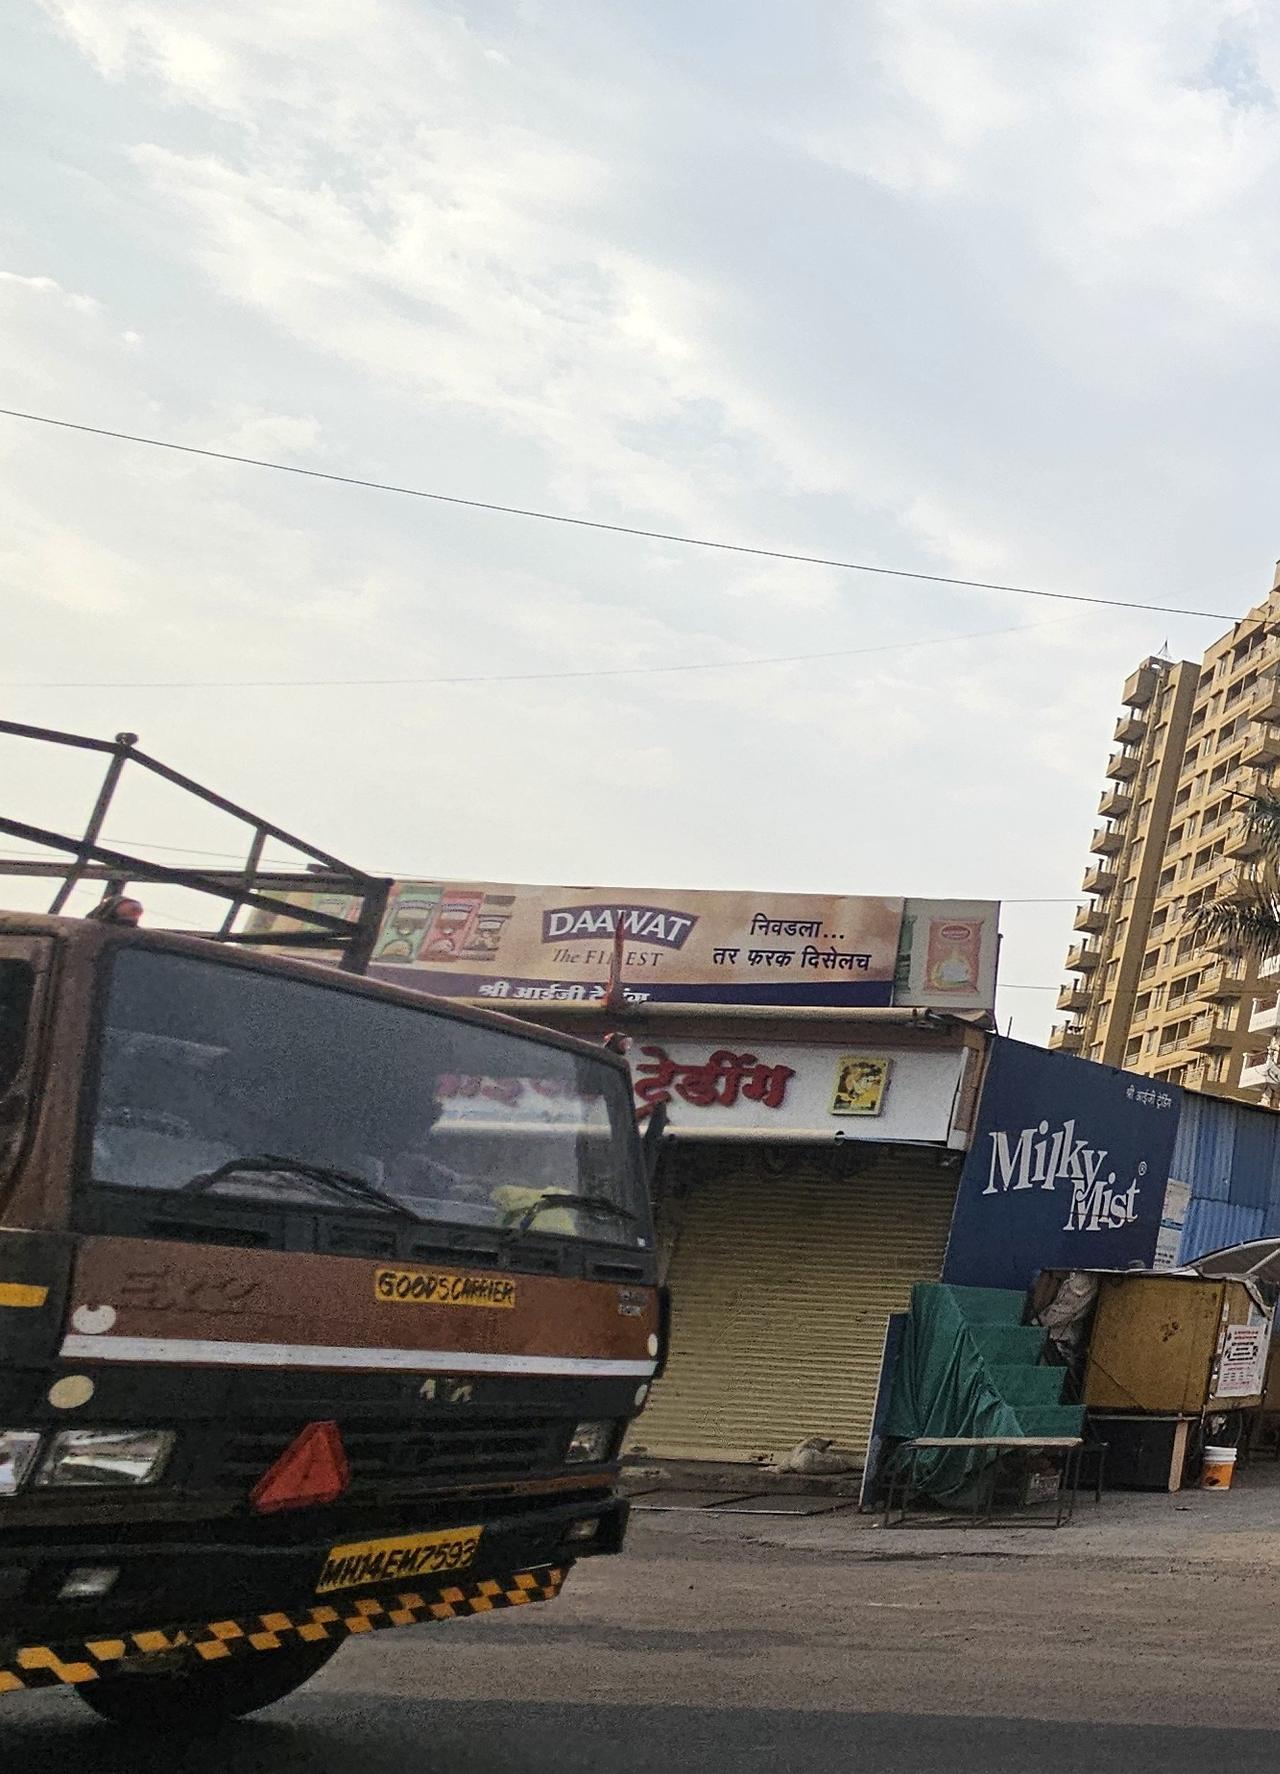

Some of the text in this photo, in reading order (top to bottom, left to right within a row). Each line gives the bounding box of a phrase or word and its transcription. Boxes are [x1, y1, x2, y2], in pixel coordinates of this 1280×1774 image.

[549, 909, 691, 942] DAAWAT
[552, 948, 664, 967] The FIEST
[713, 945, 872, 971] तर फरक दिसेलच
[982, 1119, 1108, 1201] Milky
[1062, 1171, 1141, 1231] Mist
